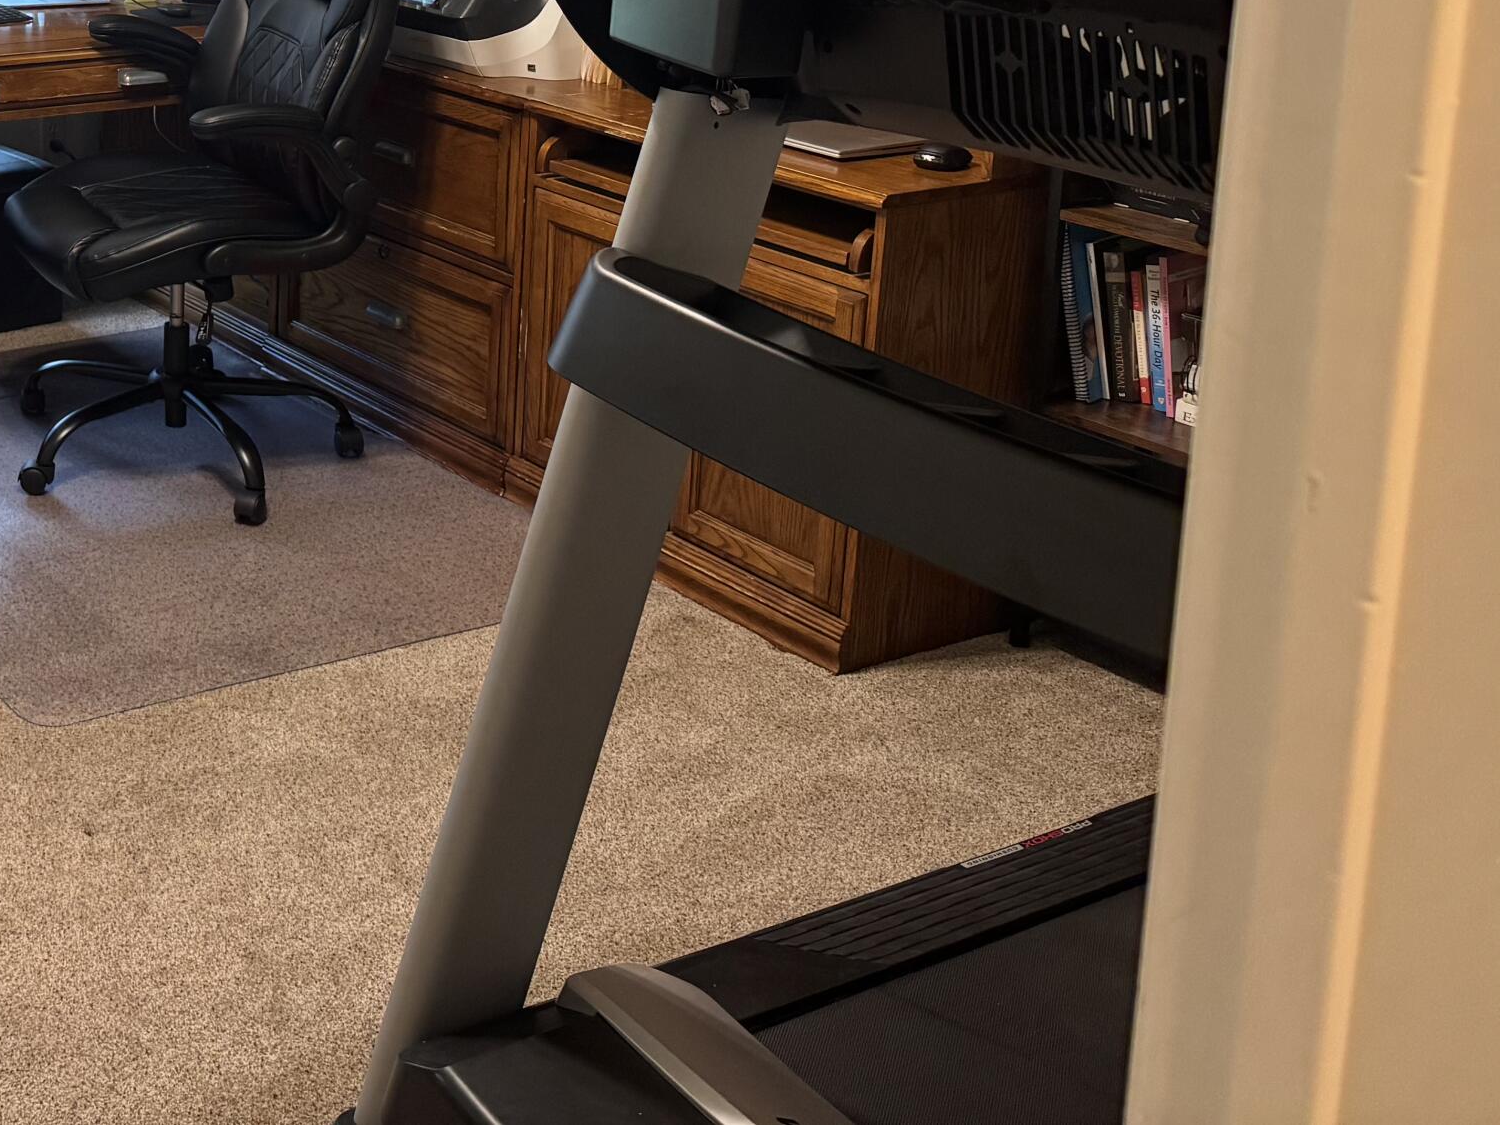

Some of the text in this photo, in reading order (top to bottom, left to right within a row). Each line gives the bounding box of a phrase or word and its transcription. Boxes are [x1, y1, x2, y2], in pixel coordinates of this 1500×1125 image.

[1150, 289, 1163, 370] The 36-Hour Day
